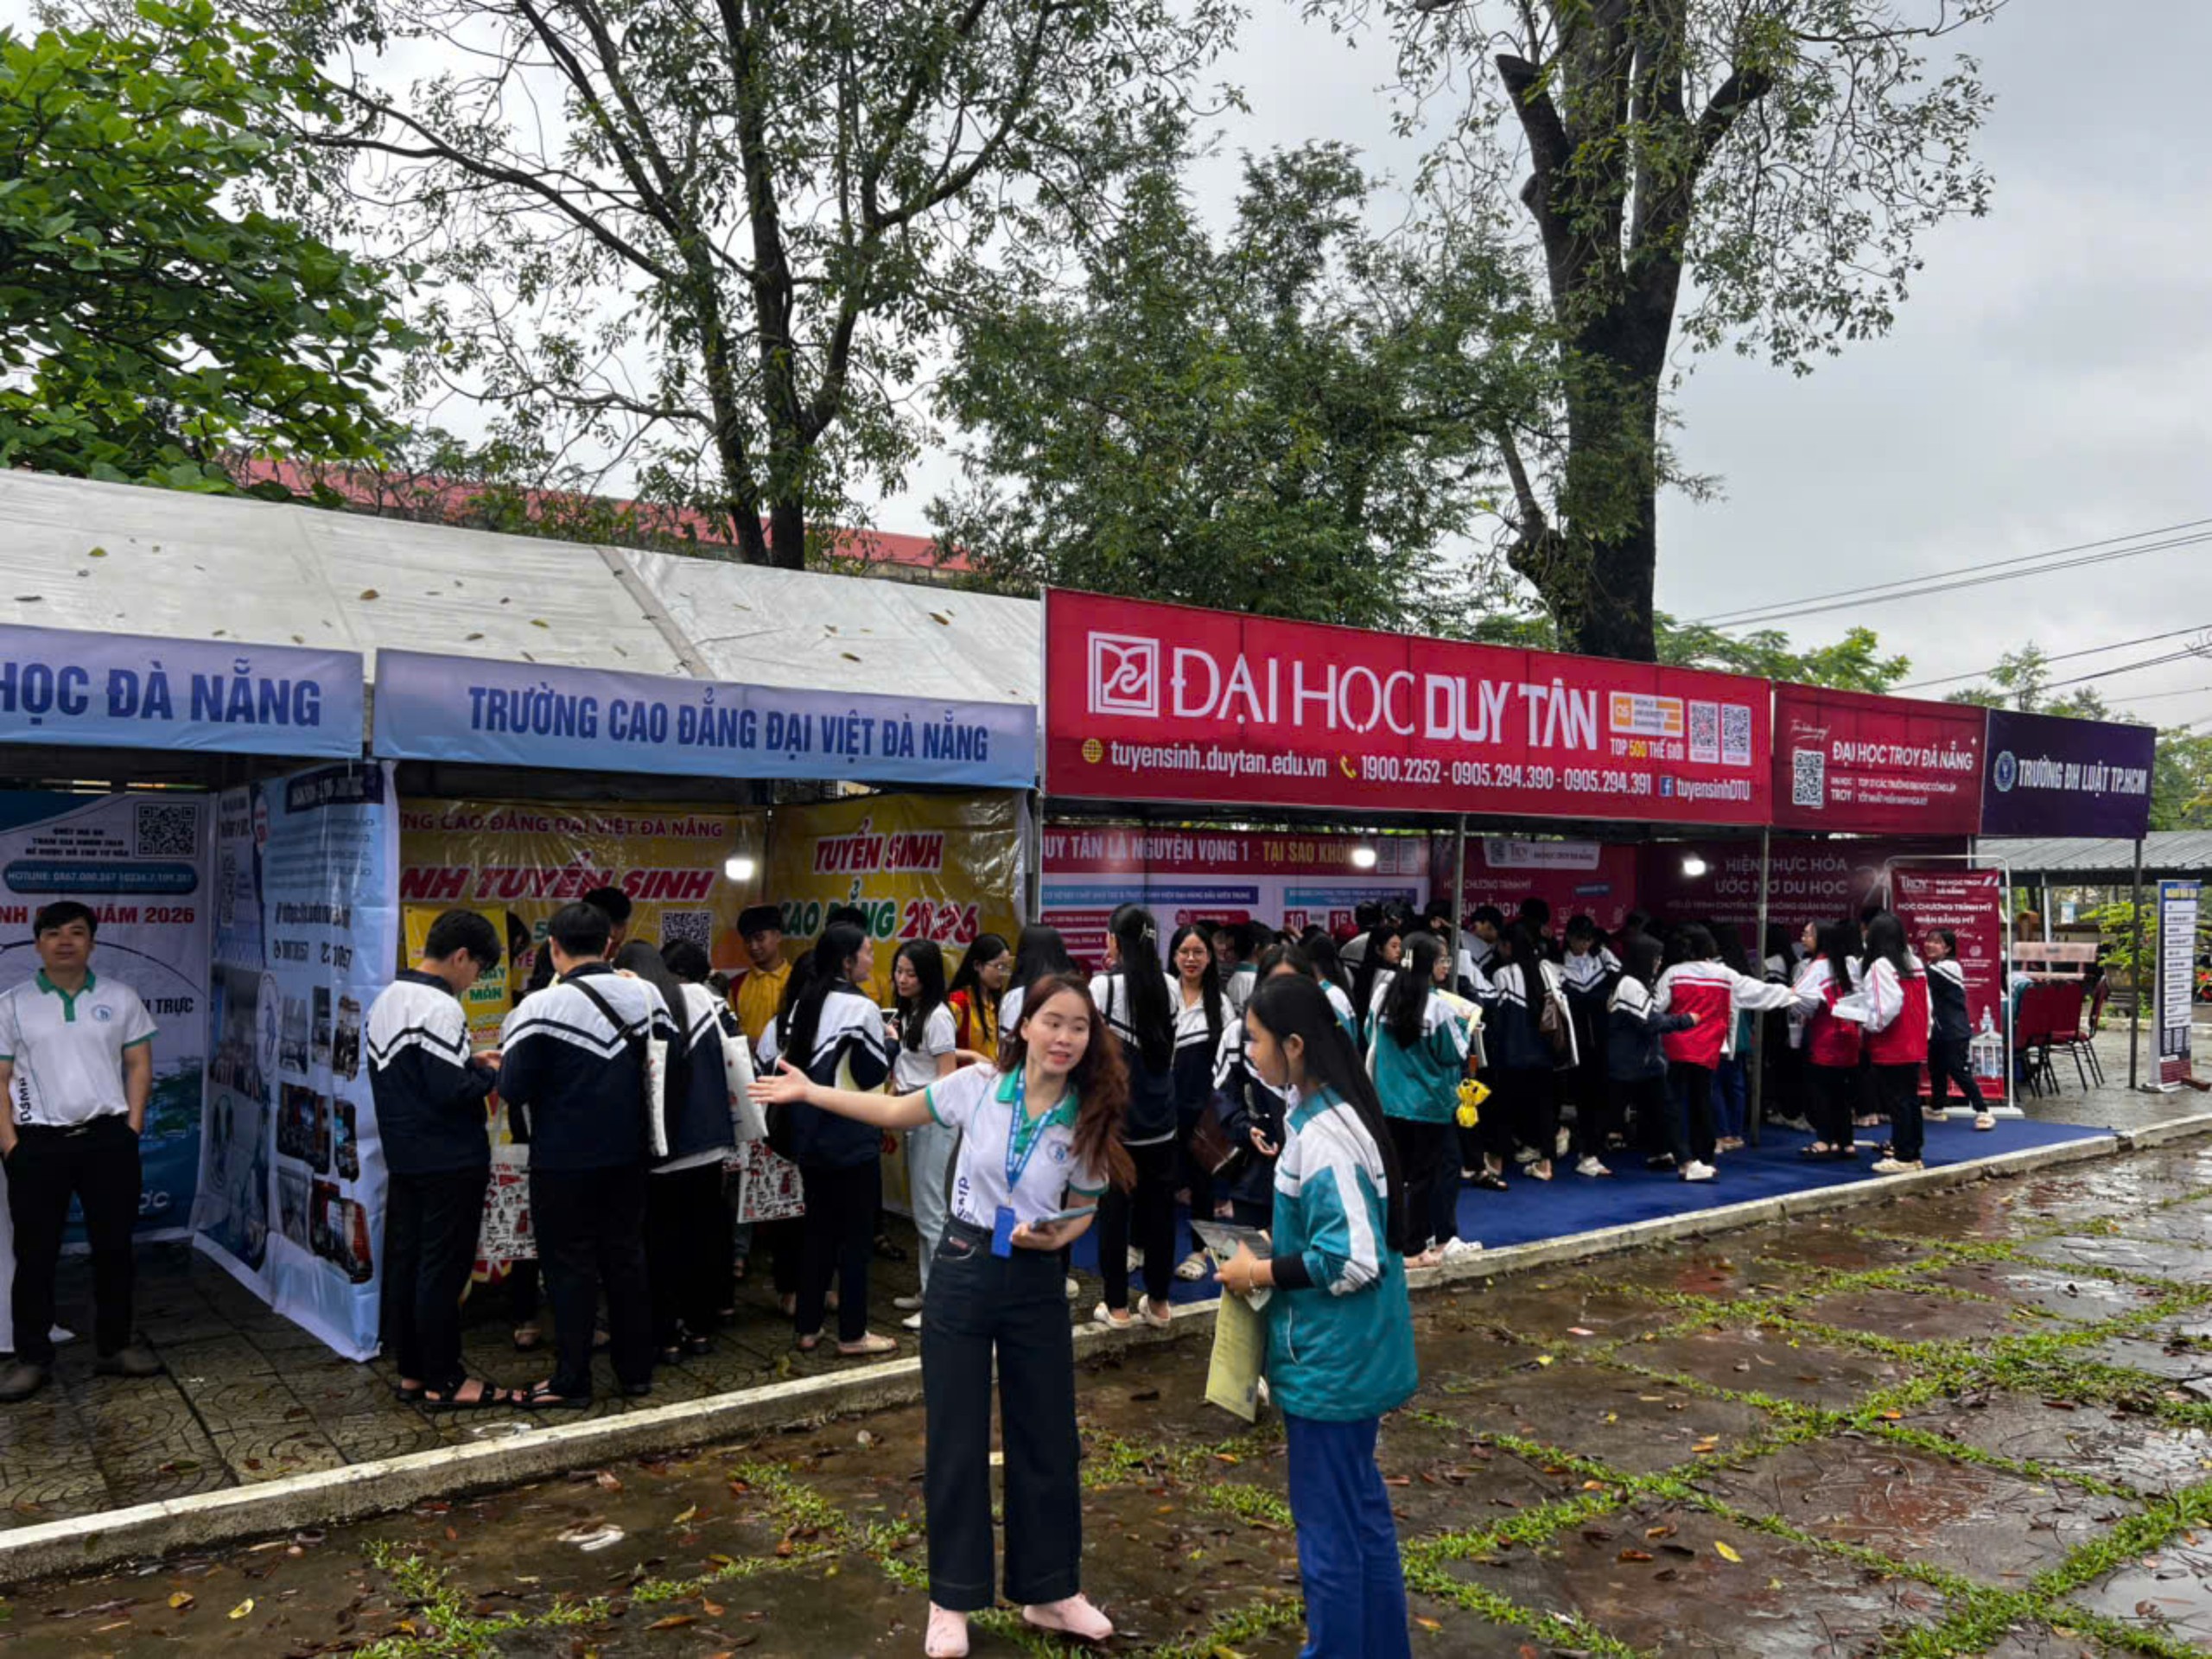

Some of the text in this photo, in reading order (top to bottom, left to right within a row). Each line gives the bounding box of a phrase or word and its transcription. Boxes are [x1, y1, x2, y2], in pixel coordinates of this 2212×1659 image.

[107, 660, 173, 720] ĐÀ
[191, 658, 321, 727] NẴNG
[1171, 647, 1598, 750] ĐẠI HỌC DUY TÂN
[468, 682, 988, 764] TRƯỜNG CAO ĐẲNG ĐẠI VIỆT ĐÀ NẴNG
[1610, 737, 1628, 757] TOP
[1629, 740, 1648, 758] 500
[1649, 737, 1666, 760] THẾ
[1833, 741, 1974, 771] ĐẠI HỌC TROY ĐÀ NẴNG
[1111, 741, 1327, 778] tuyensinh.duytan.edu.vn
[1362, 755, 1440, 784] 1900.2252
[1452, 762, 1554, 790] 0905.294.390
[1564, 768, 1651, 794] 0905.294.391
[1677, 778, 1750, 802] tuyensinhDTU
[2019, 754, 2147, 798] TRƯỜNG ĐH LUẬT TP.HCM
[1830, 788, 1852, 802] TROY
[442, 814, 484, 830] CAO
[491, 810, 549, 832] ĐẲNG
[595, 817, 636, 837] VIỆT
[641, 817, 666, 836] ĐÀ
[672, 817, 722, 837] NẴNG
[815, 819, 944, 872] TUYỂN SINH
[1043, 835, 1066, 860] UY
[1071, 832, 1103, 860] TÂN
[1108, 832, 1127, 860] LÀ
[1132, 834, 1193, 866] NGUYỆN
[1198, 839, 1237, 866] VỌNG
[1242, 842, 1249, 862] 1
[1262, 842, 1283, 868] TẠI
[1288, 842, 1313, 863] SAO
[476, 850, 614, 899] TUYỂN
[622, 869, 715, 899] SINH
[1726, 853, 1761, 875] HIỆN
[1783, 880, 1805, 894] DU
[1810, 880, 1848, 898] HỌC
[144, 906, 194, 924] 2026
[899, 901, 978, 944] 2026
[156, 997, 194, 1017] TRỰC
